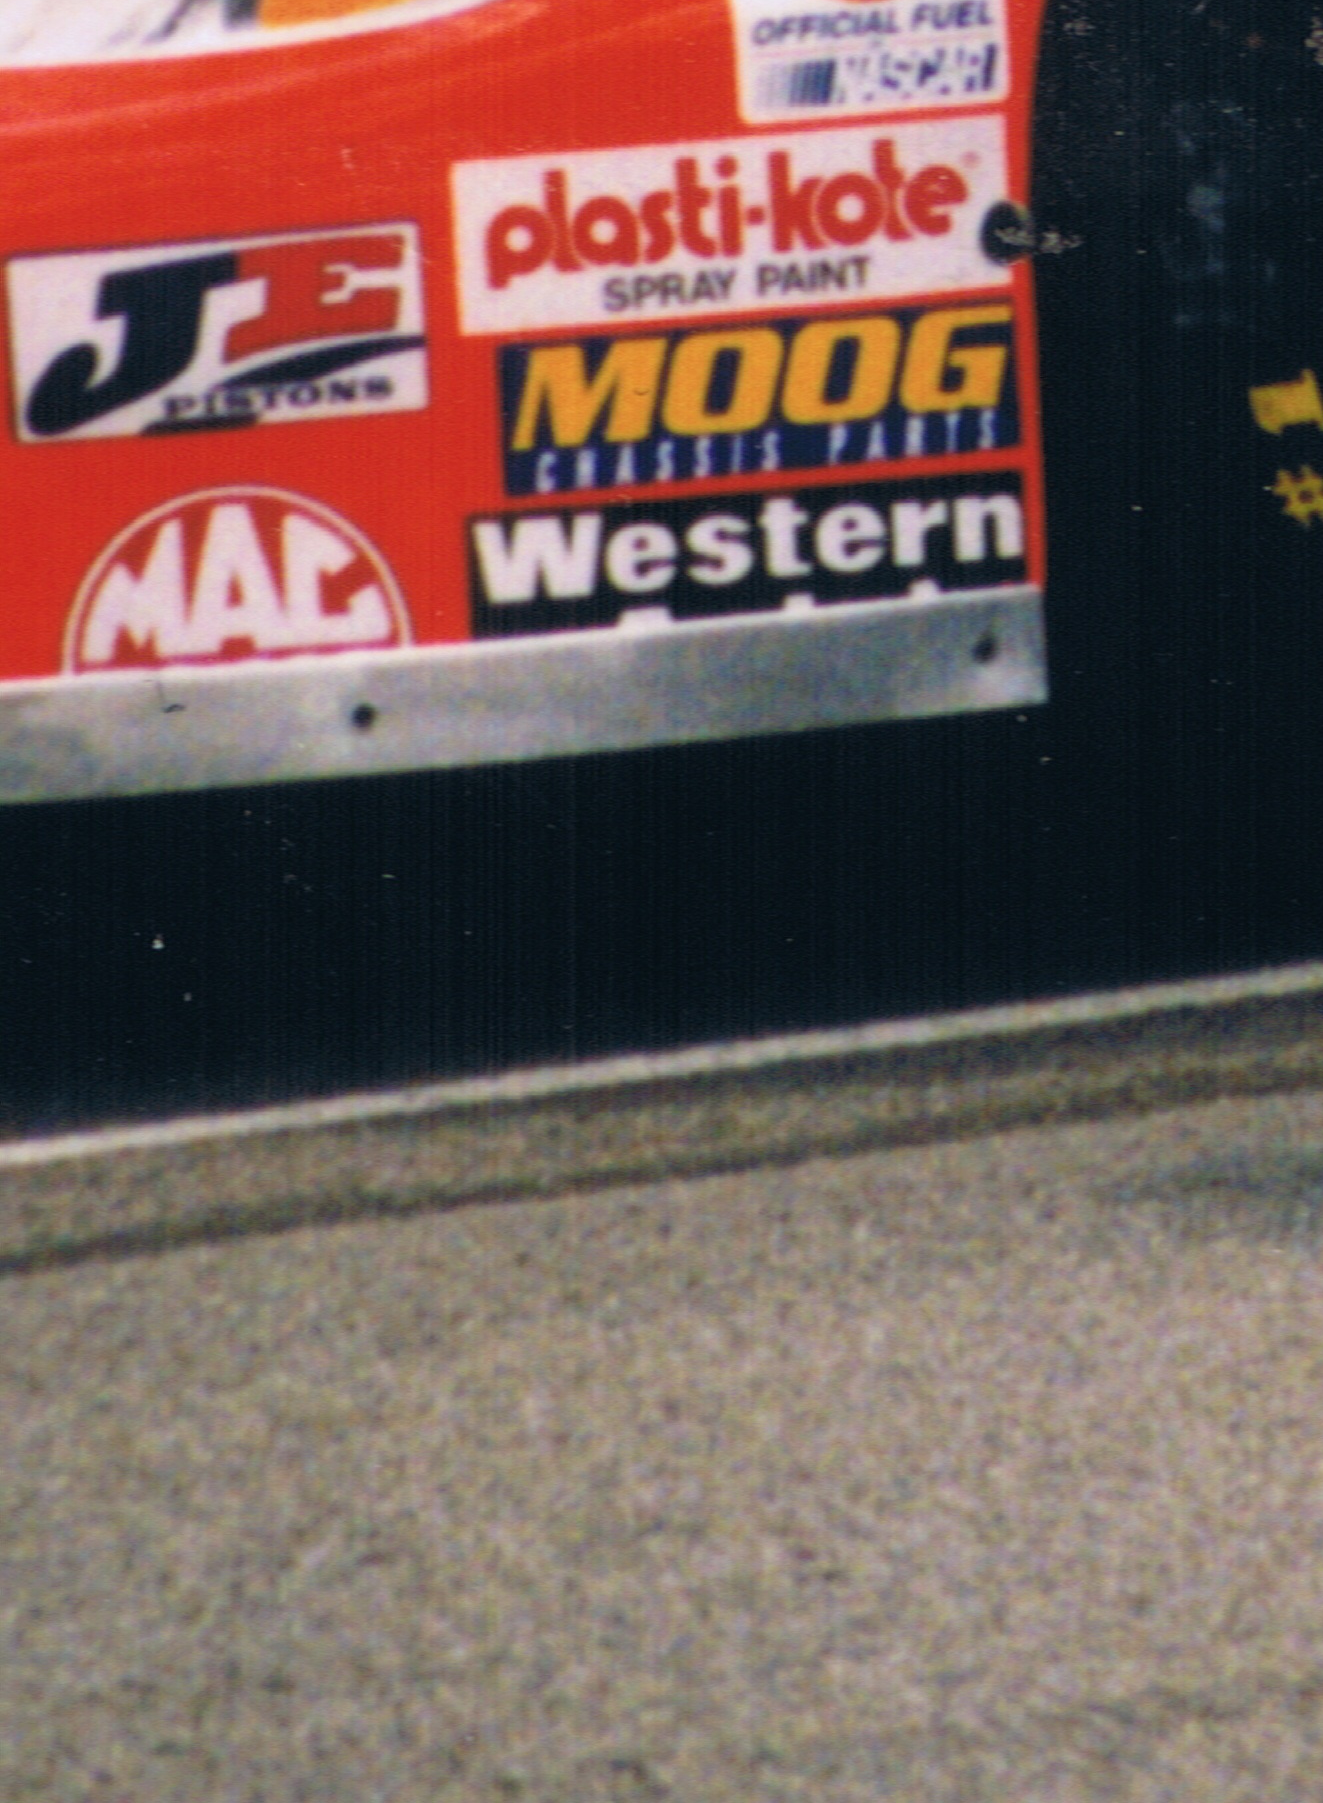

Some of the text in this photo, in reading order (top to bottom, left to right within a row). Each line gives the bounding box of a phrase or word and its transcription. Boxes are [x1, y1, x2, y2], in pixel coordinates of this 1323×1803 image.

[751, 6, 900, 47] OFFICIAL
[484, 136, 968, 290] plasti-kote
[25, 233, 403, 436] JE
[602, 255, 873, 313] SPRAY PAINT
[163, 375, 395, 422] PISTONS
[510, 305, 1014, 452] MOOG
[534, 406, 997, 494] CHASSIS PARTS
[81, 501, 392, 665] MAC
[472, 491, 1025, 605] Western
